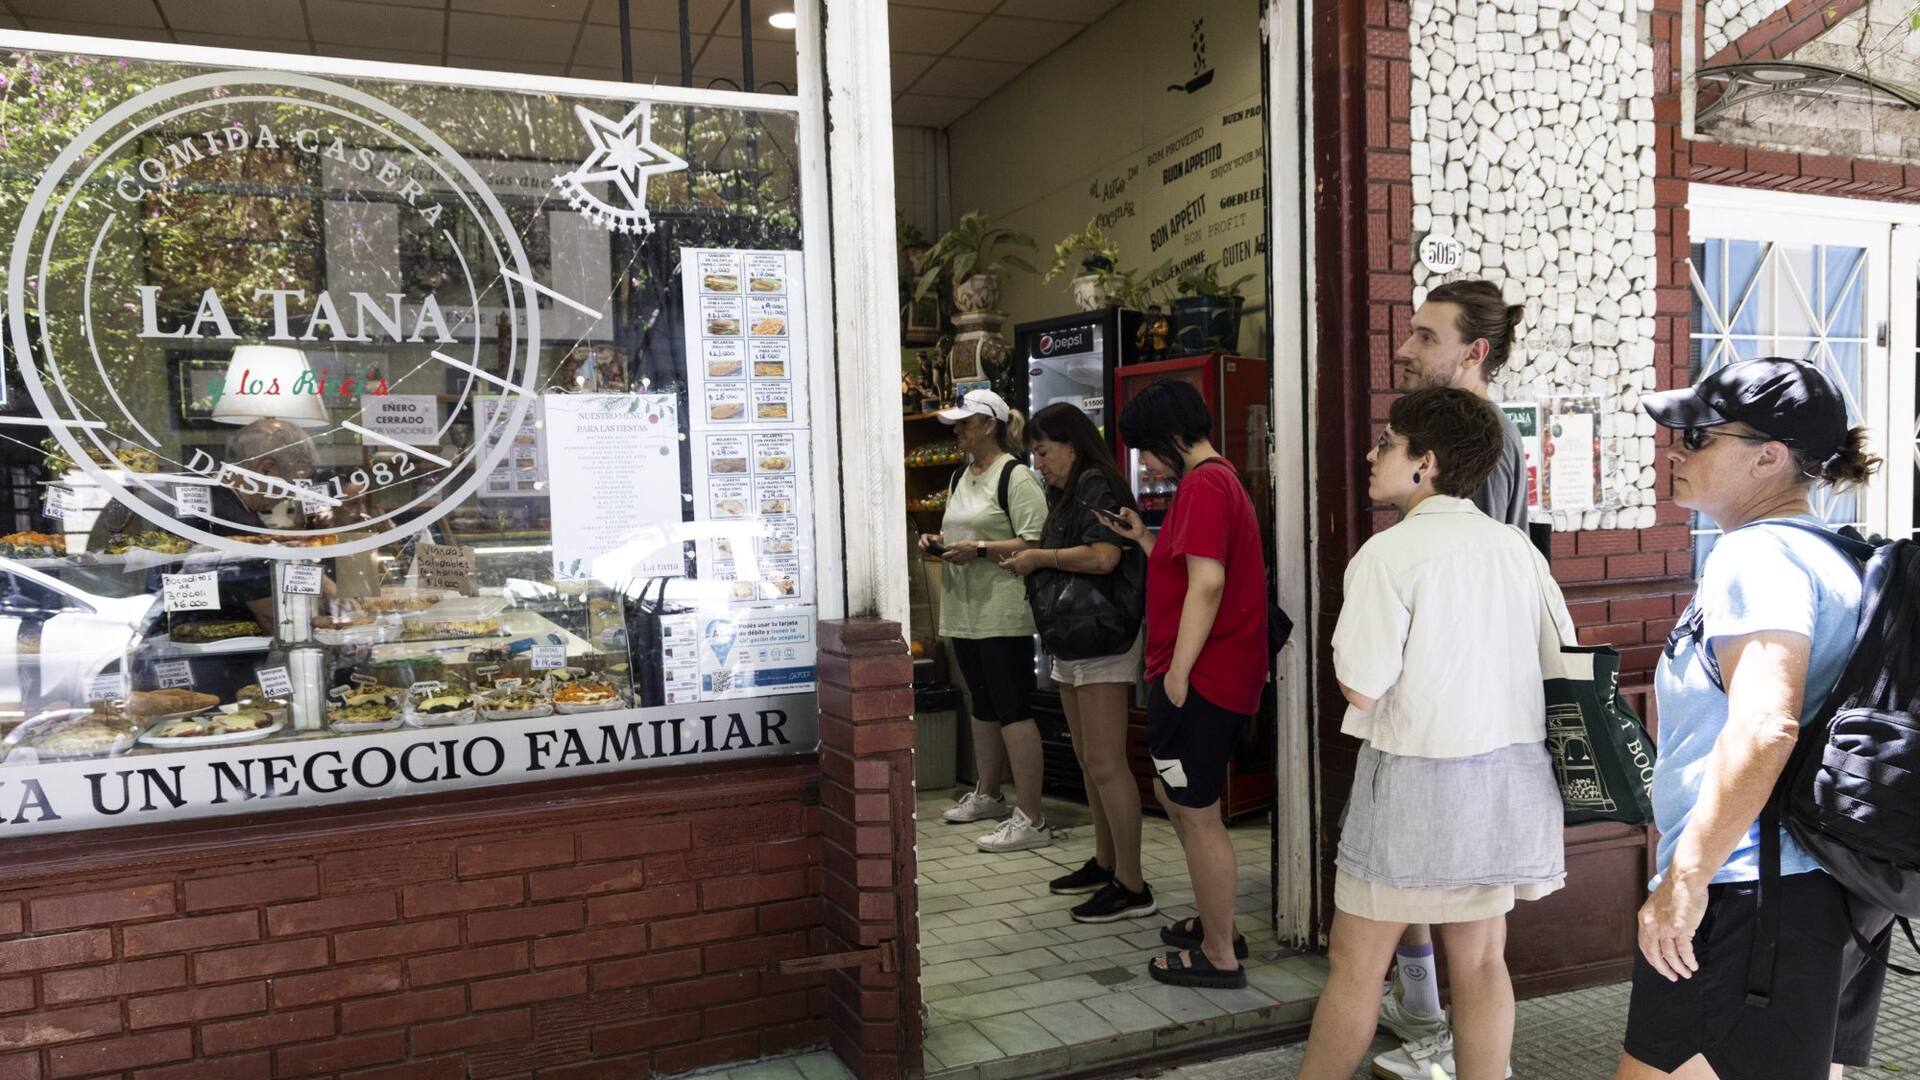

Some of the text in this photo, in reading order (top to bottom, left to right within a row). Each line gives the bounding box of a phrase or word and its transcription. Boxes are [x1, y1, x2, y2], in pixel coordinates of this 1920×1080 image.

[1222, 113, 1243, 126] BUEN
[1147, 126, 1205, 168] BOM PROVEITO
[116, 124, 444, 228] COMIDA CASERA
[1163, 142, 1222, 185] BUON APPETITO
[1210, 161, 1233, 180] ENJOY
[1233, 153, 1254, 169] YOUR
[1220, 192, 1248, 210] GOEDE
[1150, 226, 1169, 253] BON
[1184, 213, 1247, 246] BON PROFIT
[1222, 239, 1251, 268] GUTEN
[1428, 241, 1456, 264] 5015
[135, 284, 458, 343] LA TANA
[1054, 334, 1082, 351] pepsi
[236, 369, 280, 395] los
[376, 416, 424, 424] CERRADO
[577, 425, 600, 433] PARA
[615, 424, 648, 432] FIESTAS
[578, 412, 617, 421] NUESTRO
[184, 448, 312, 500] DESDE
[331, 452, 416, 499] 1982
[164, 574, 212, 585] Bocaditos
[167, 591, 207, 600] Brocoli
[83, 765, 188, 815] UN
[208, 736, 505, 804] NEGOCIO
[524, 709, 791, 771] FAMILIAR
